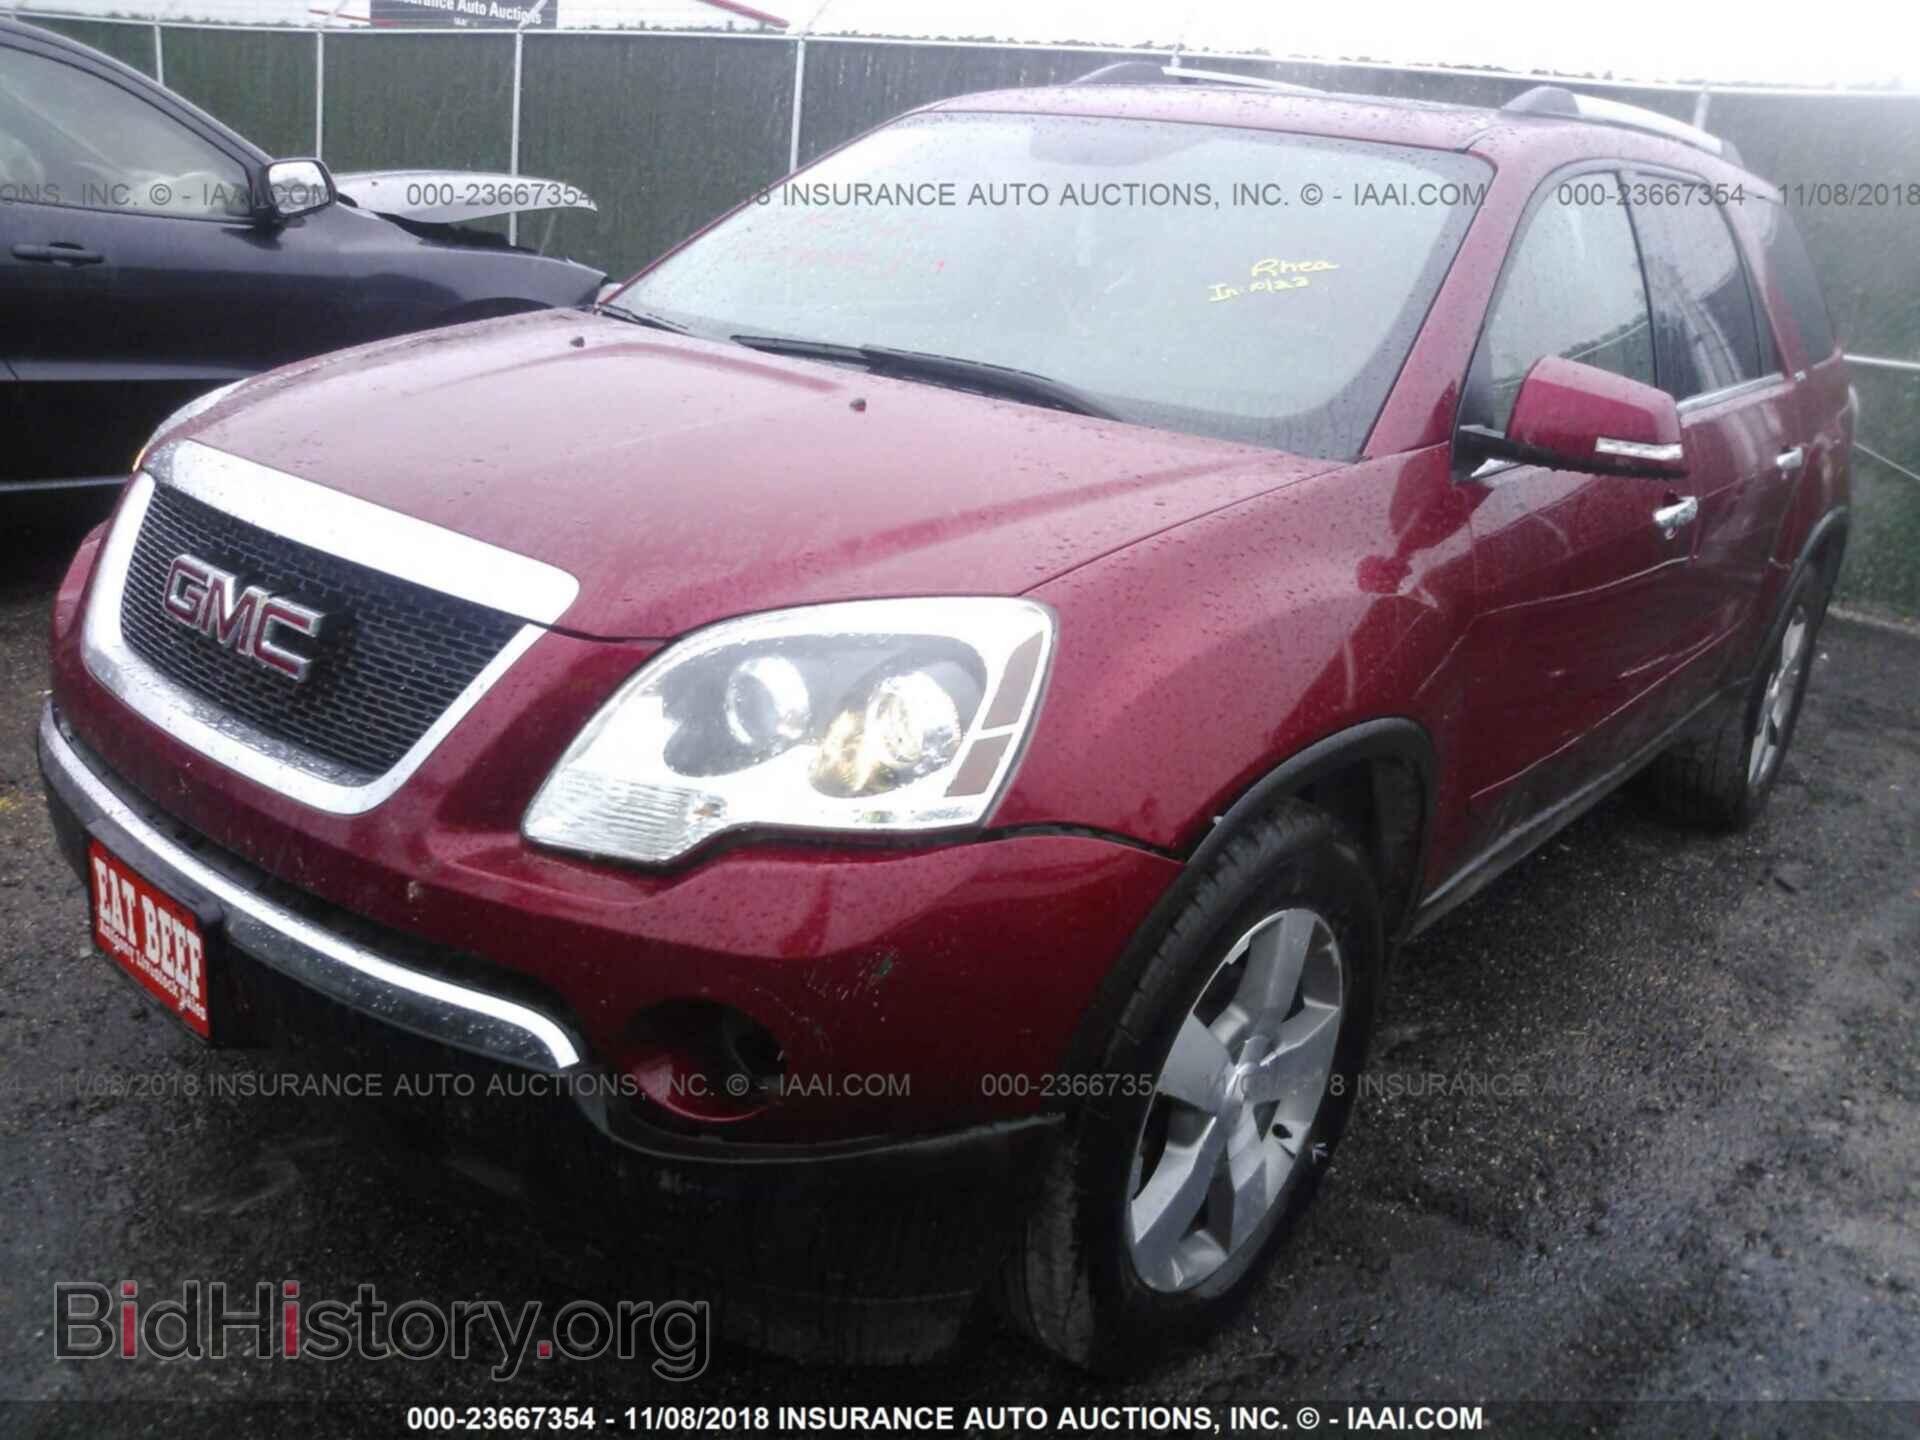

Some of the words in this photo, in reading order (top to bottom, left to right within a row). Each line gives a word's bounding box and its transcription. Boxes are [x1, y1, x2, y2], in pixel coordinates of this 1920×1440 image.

[457, 0, 487, 16] Auto
[163, 554, 327, 682] GMC
[94, 857, 138, 947] EAT
[141, 894, 203, 999] BEEF
